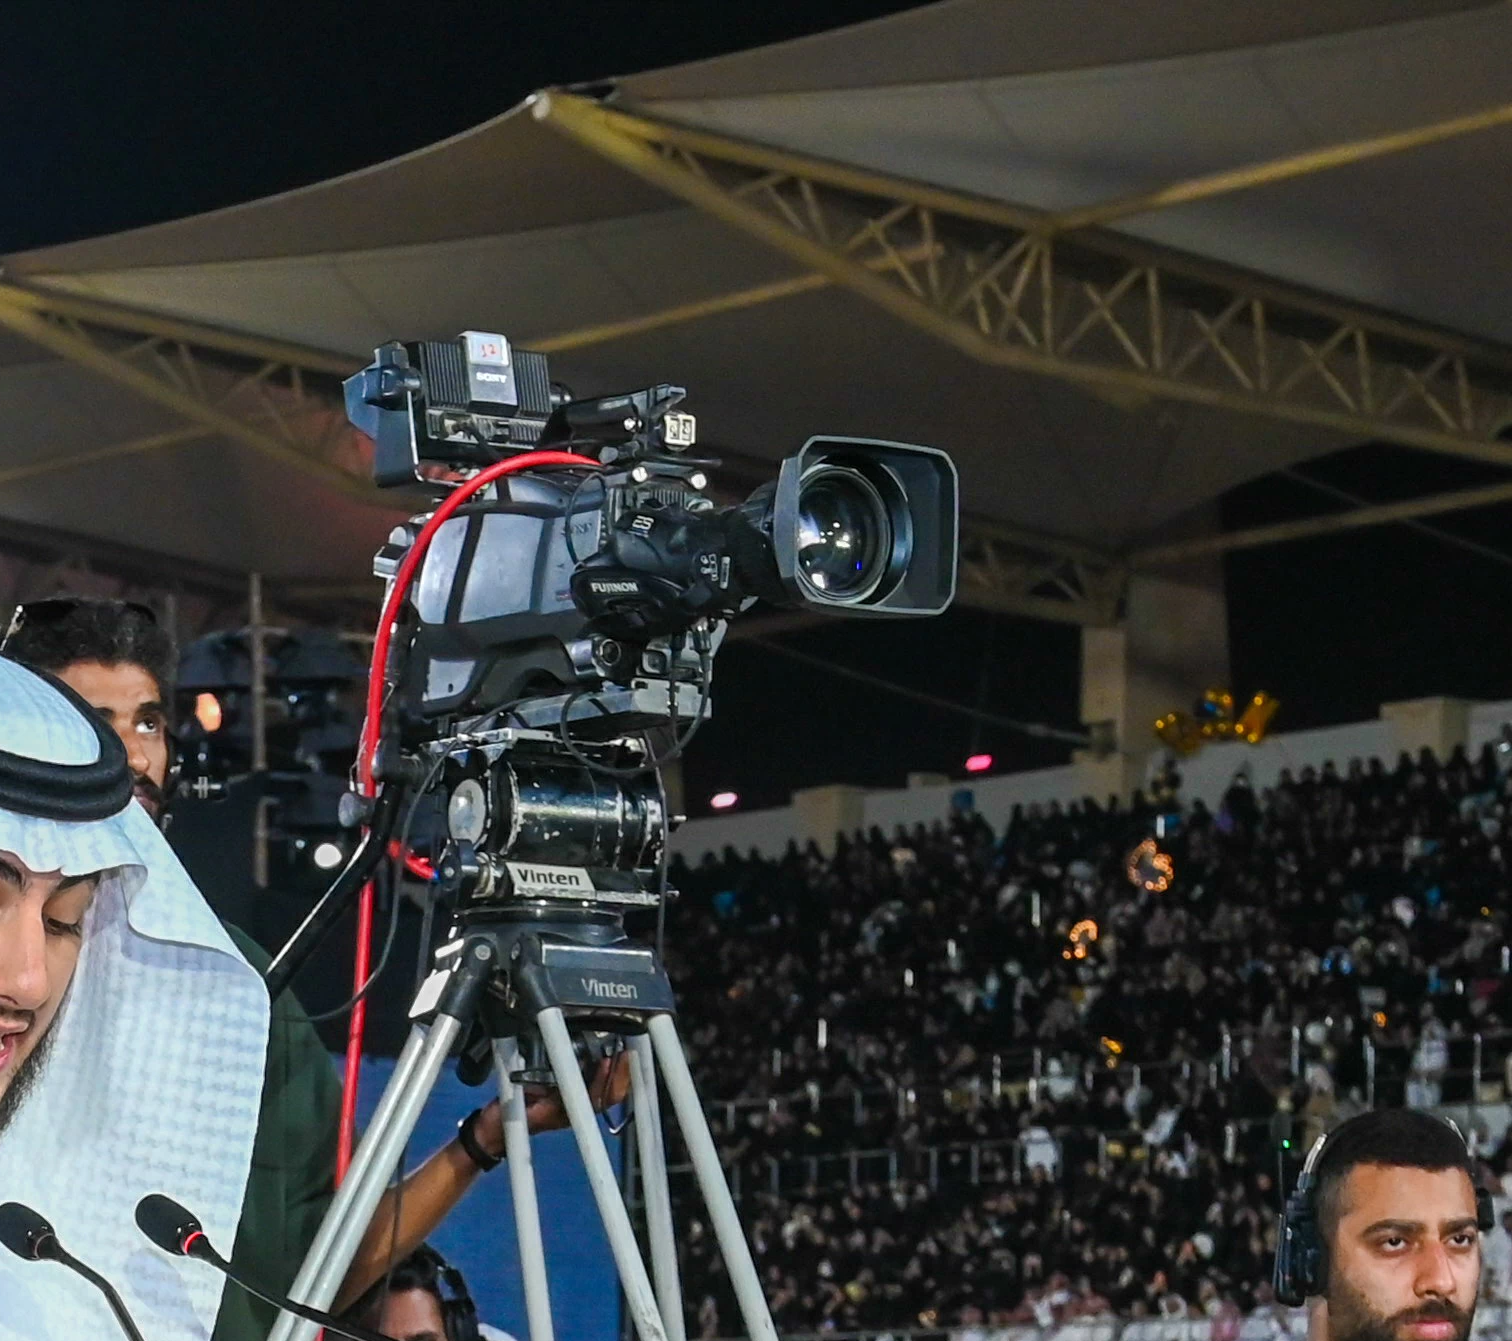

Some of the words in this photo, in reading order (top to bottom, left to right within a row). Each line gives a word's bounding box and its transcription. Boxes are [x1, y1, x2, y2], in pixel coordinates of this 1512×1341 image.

[476, 372, 507, 383] SONY
[590, 581, 639, 594] FUJINON
[517, 868, 580, 886] Vinten
[581, 978, 638, 999] Vinten
